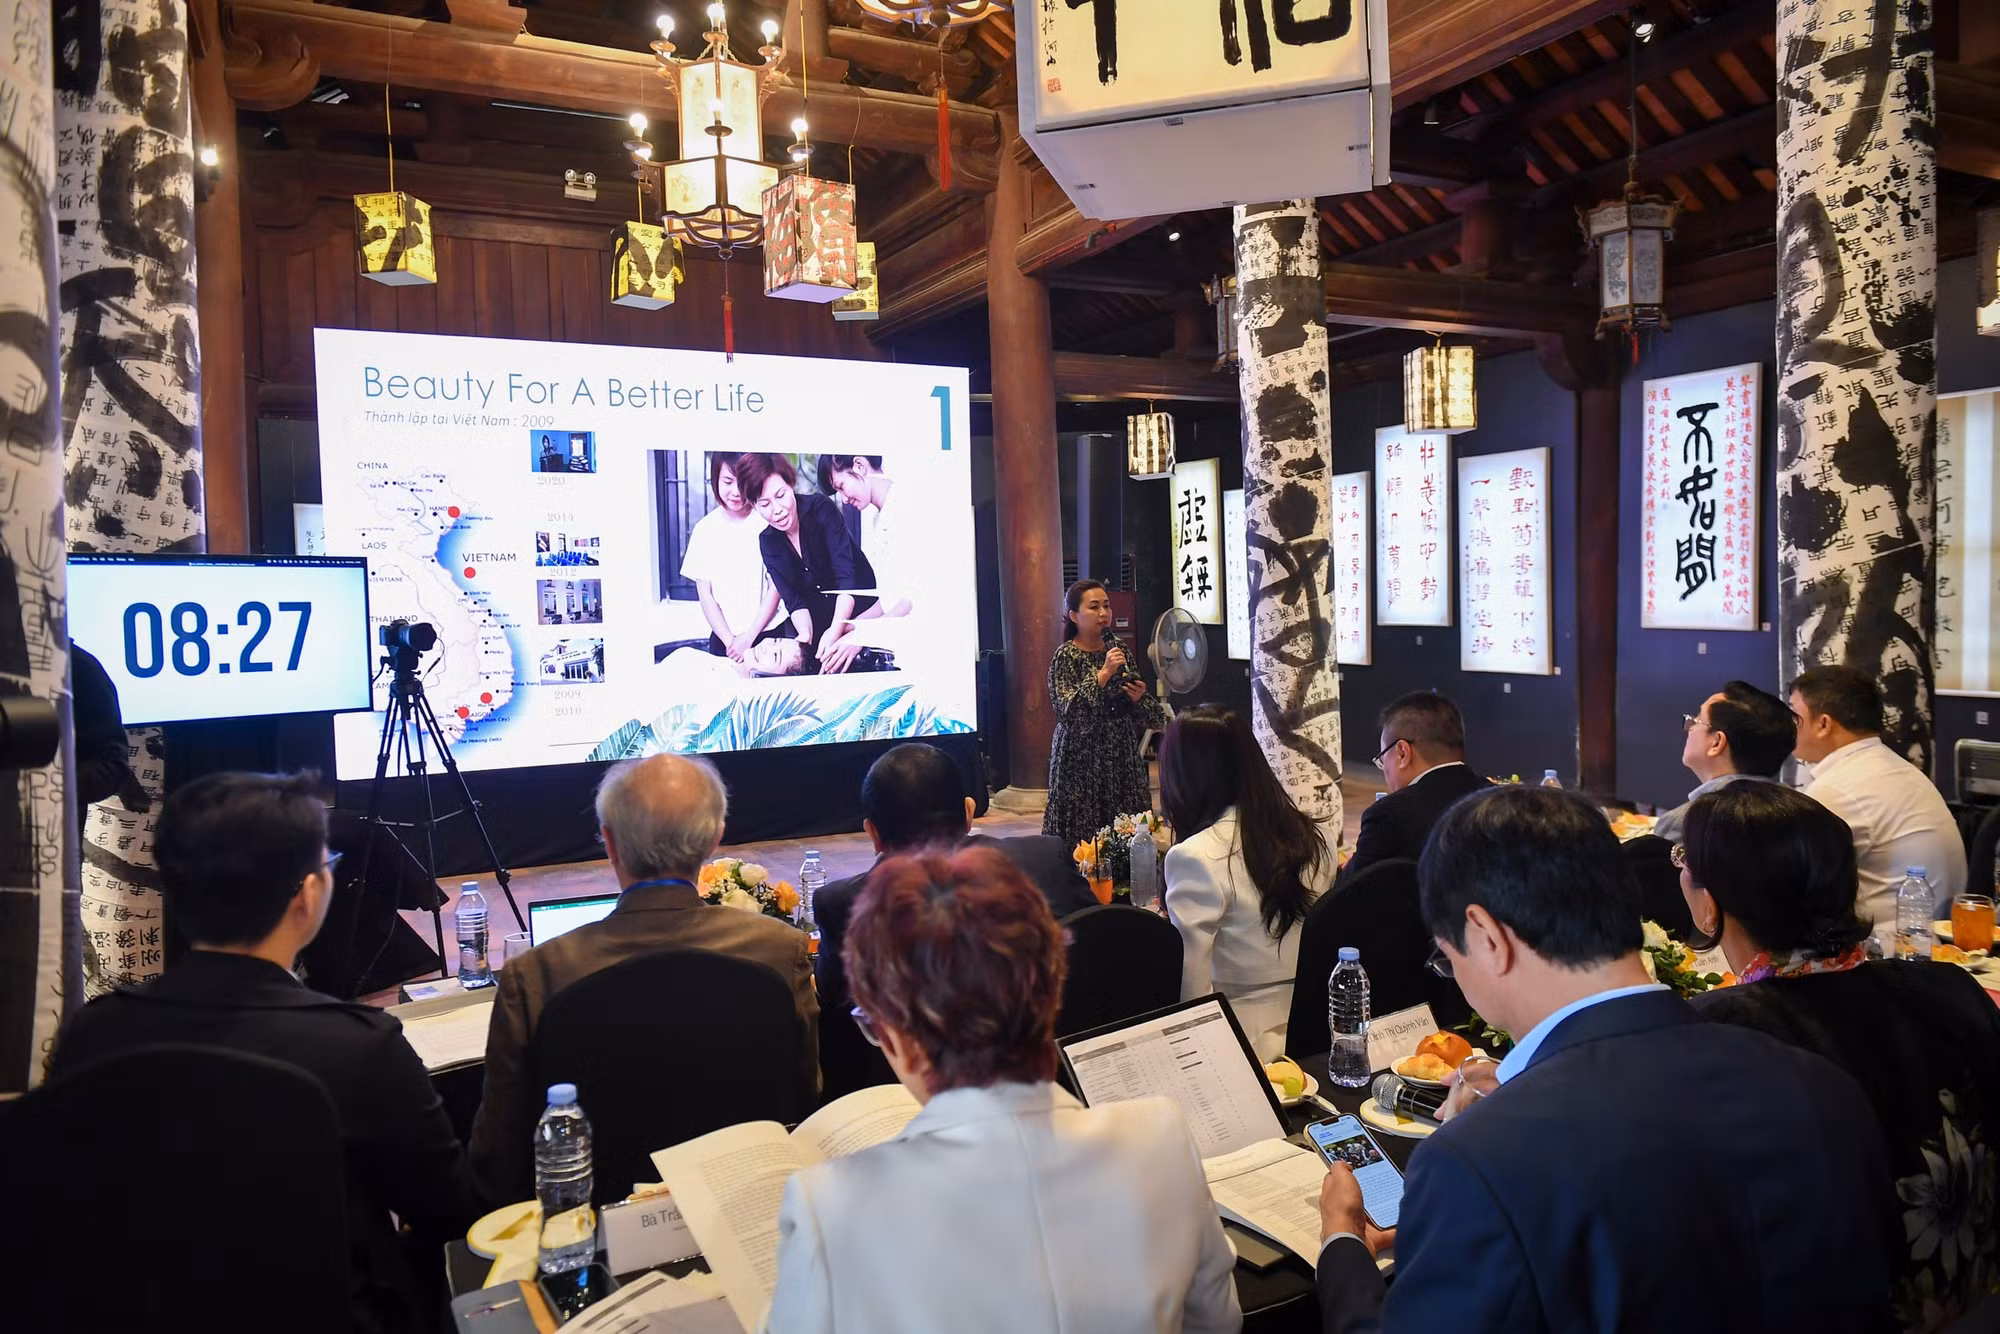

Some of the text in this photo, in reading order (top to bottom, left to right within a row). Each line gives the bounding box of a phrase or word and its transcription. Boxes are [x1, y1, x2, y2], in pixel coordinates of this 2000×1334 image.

[364, 367, 764, 412] Beauty For A Better Life
[364, 411, 404, 424] Thành
[481, 415, 510, 427] Nam
[522, 415, 554, 427] 2009
[930, 385, 951, 450] 1
[357, 462, 388, 470] CHINA
[537, 476, 565, 485] 2020
[462, 553, 517, 562] VIETNAM
[550, 568, 576, 576] 2012
[123, 600, 312, 678] 08:27
[554, 690, 581, 699] 2009
[641, 1213, 657, 1228] Bà
